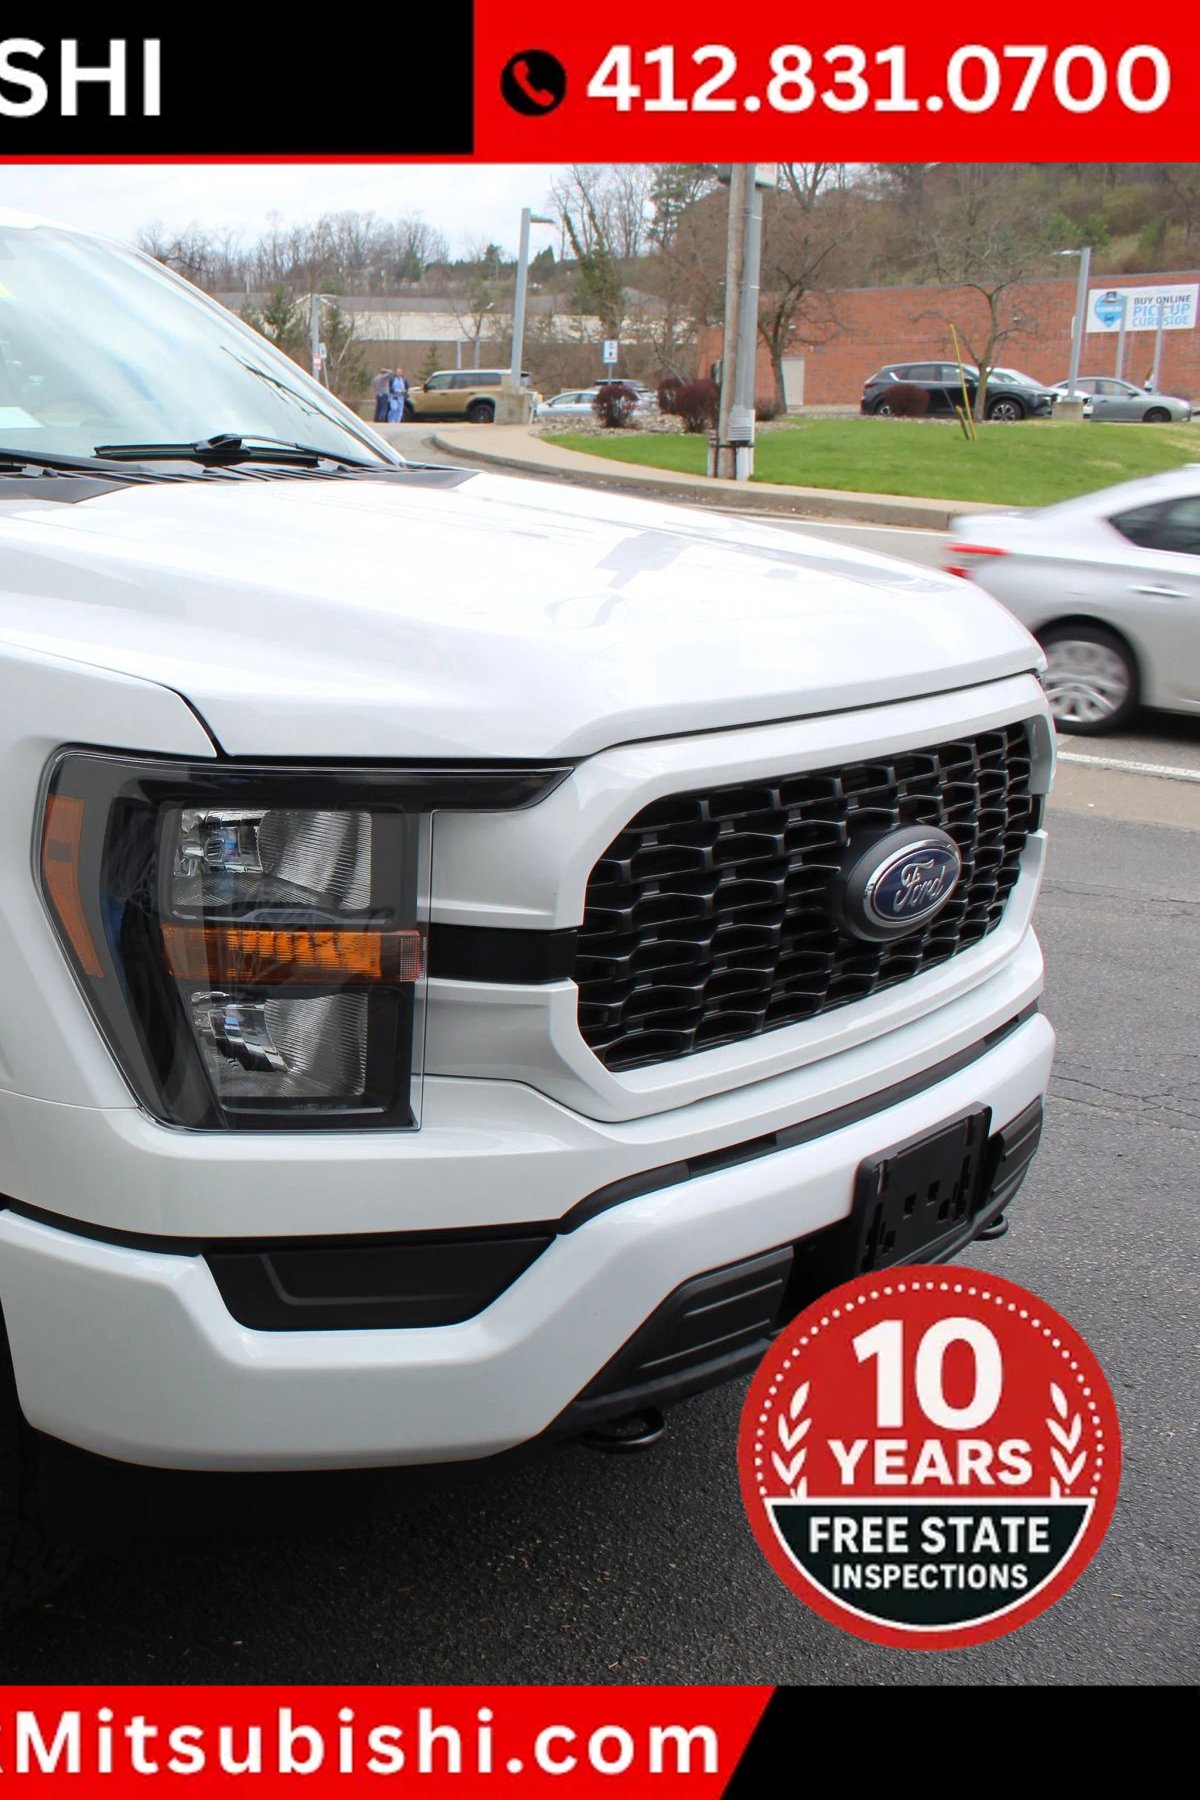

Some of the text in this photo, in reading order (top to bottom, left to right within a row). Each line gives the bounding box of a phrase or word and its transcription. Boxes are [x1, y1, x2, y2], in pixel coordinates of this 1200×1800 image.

[1134, 295, 1191, 305] BUY ONLINE
[893, 858, 946, 912] Ford
